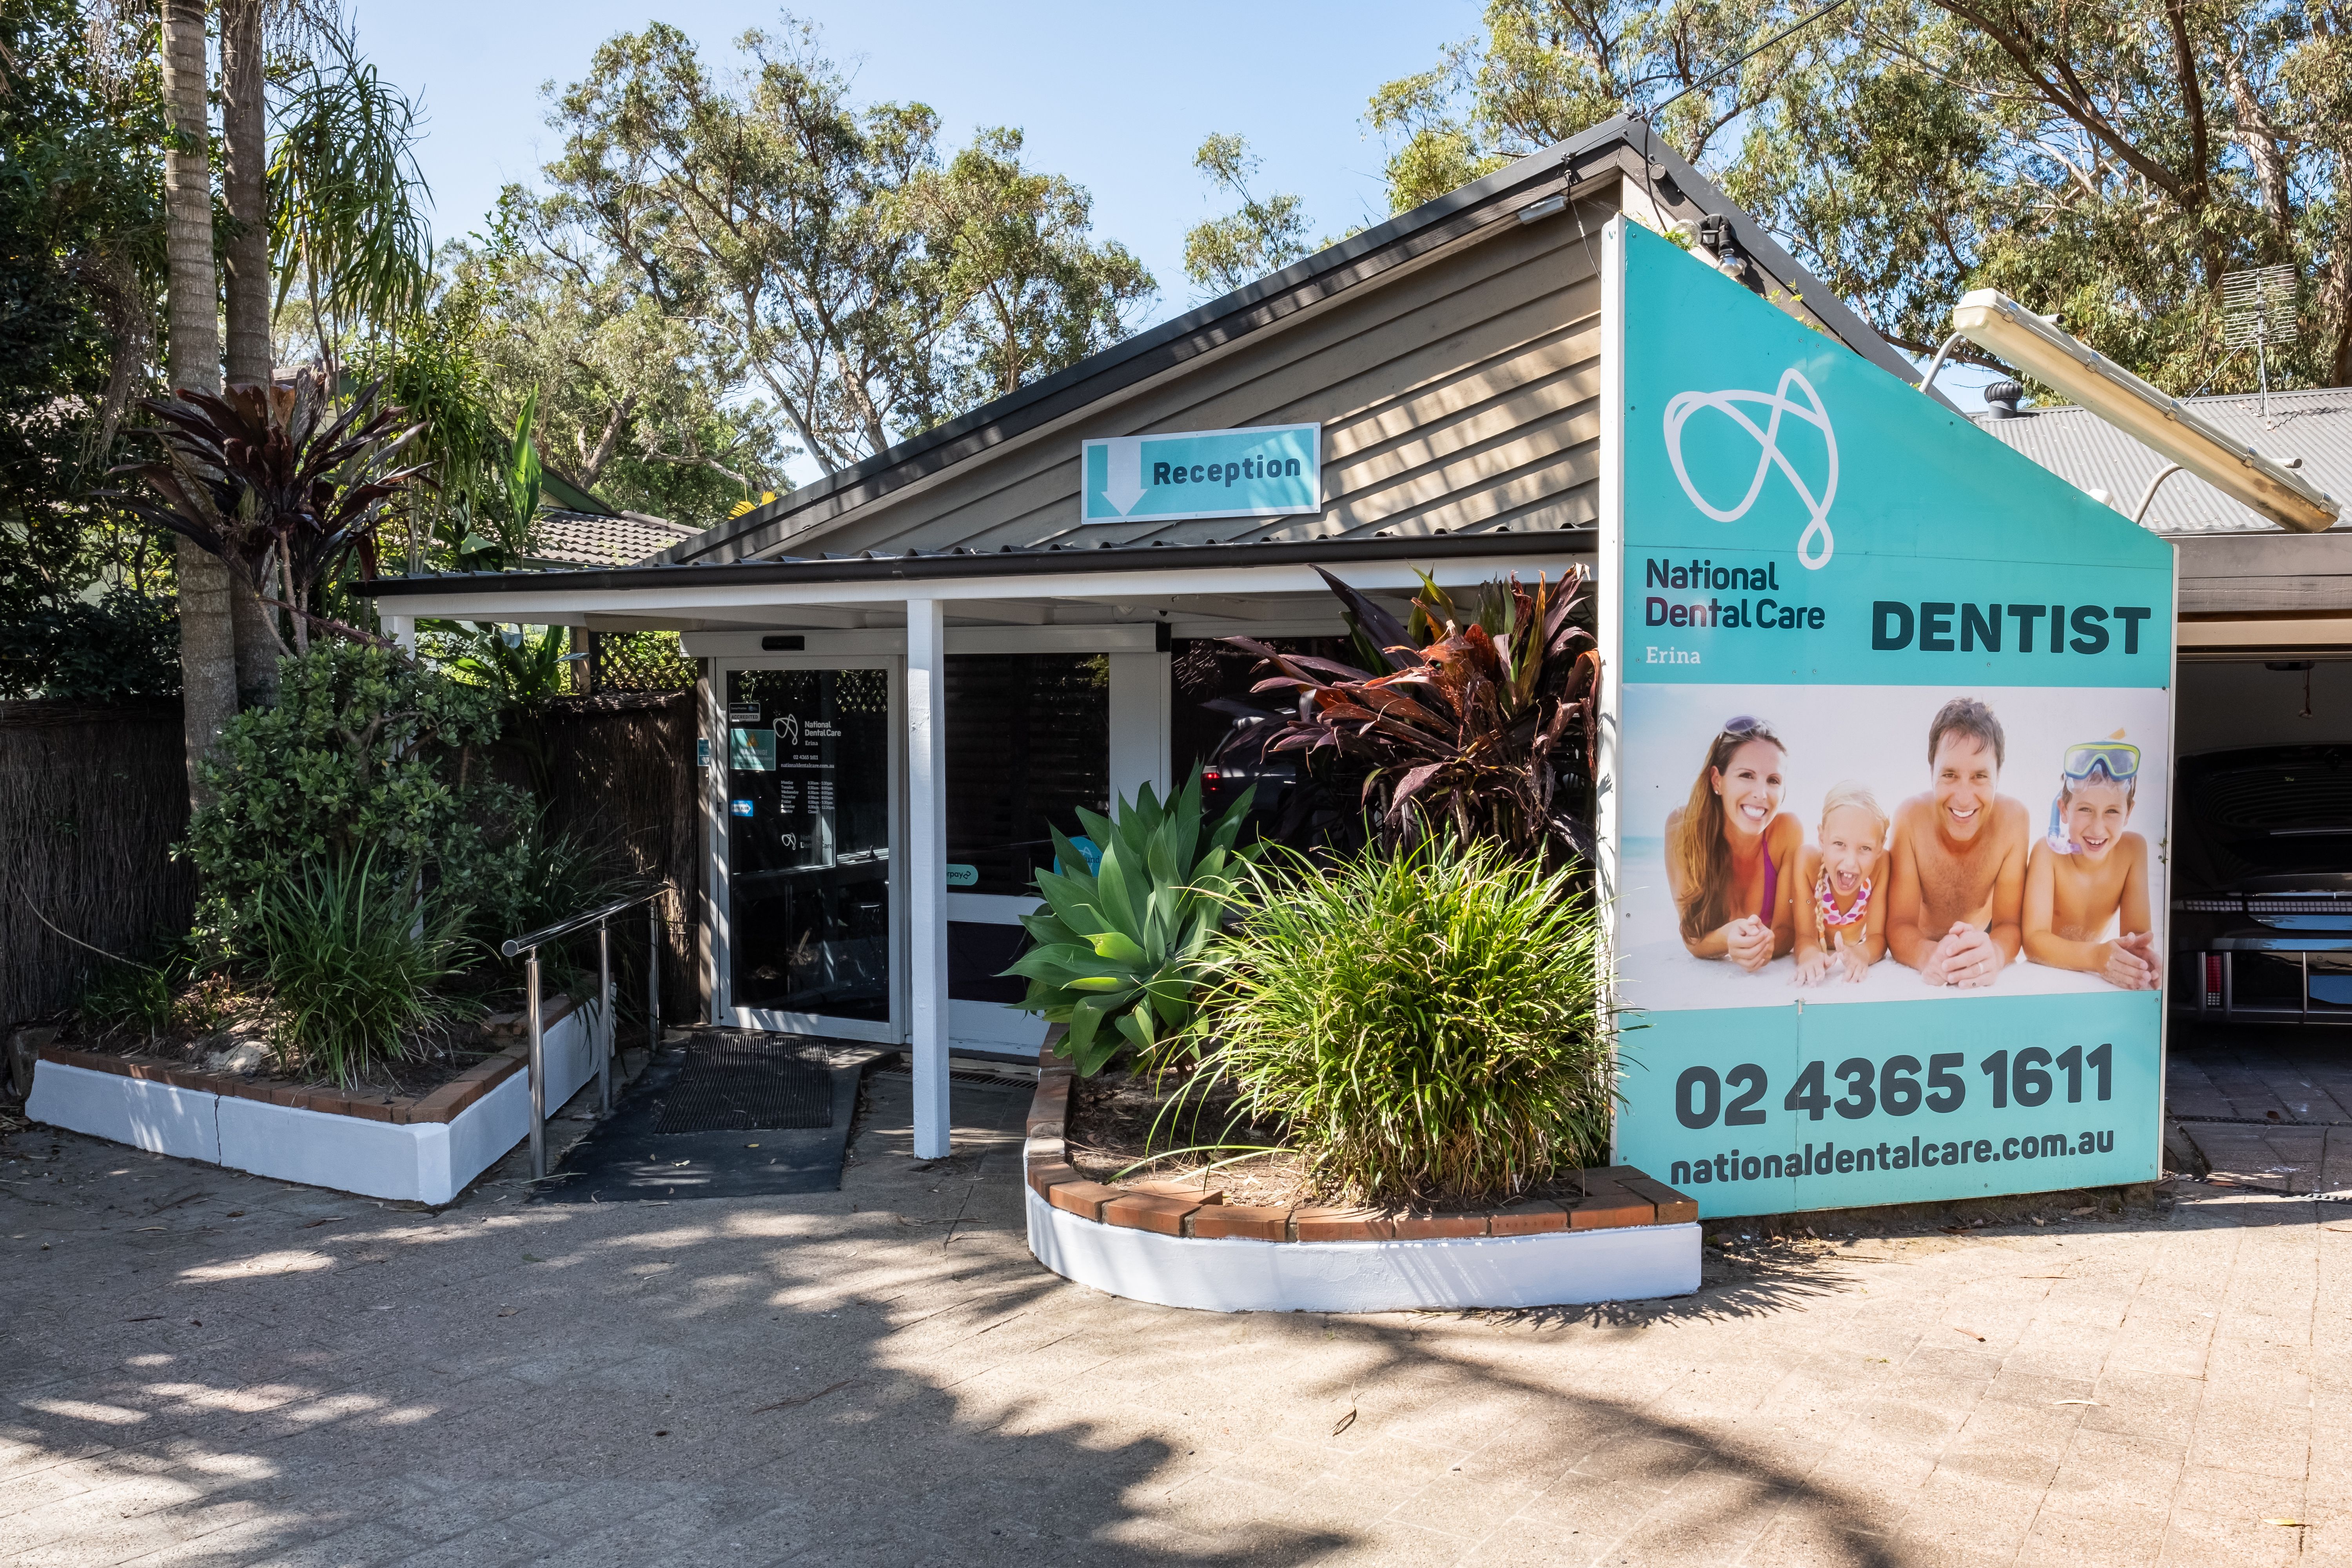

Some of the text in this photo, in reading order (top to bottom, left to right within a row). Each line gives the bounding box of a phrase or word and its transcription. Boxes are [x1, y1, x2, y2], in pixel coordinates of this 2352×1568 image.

[1154, 455, 1300, 487] Reception
[1646, 558, 1779, 591] National
[1646, 597, 1825, 630] Dental Care
[1872, 601, 2151, 655] DENTIST
[1646, 646, 1701, 664] Erina
[1675, 1043, 2112, 1129] 02 4365 1611
[1671, 1130, 2114, 1185] nationaldentalcare.com.au
